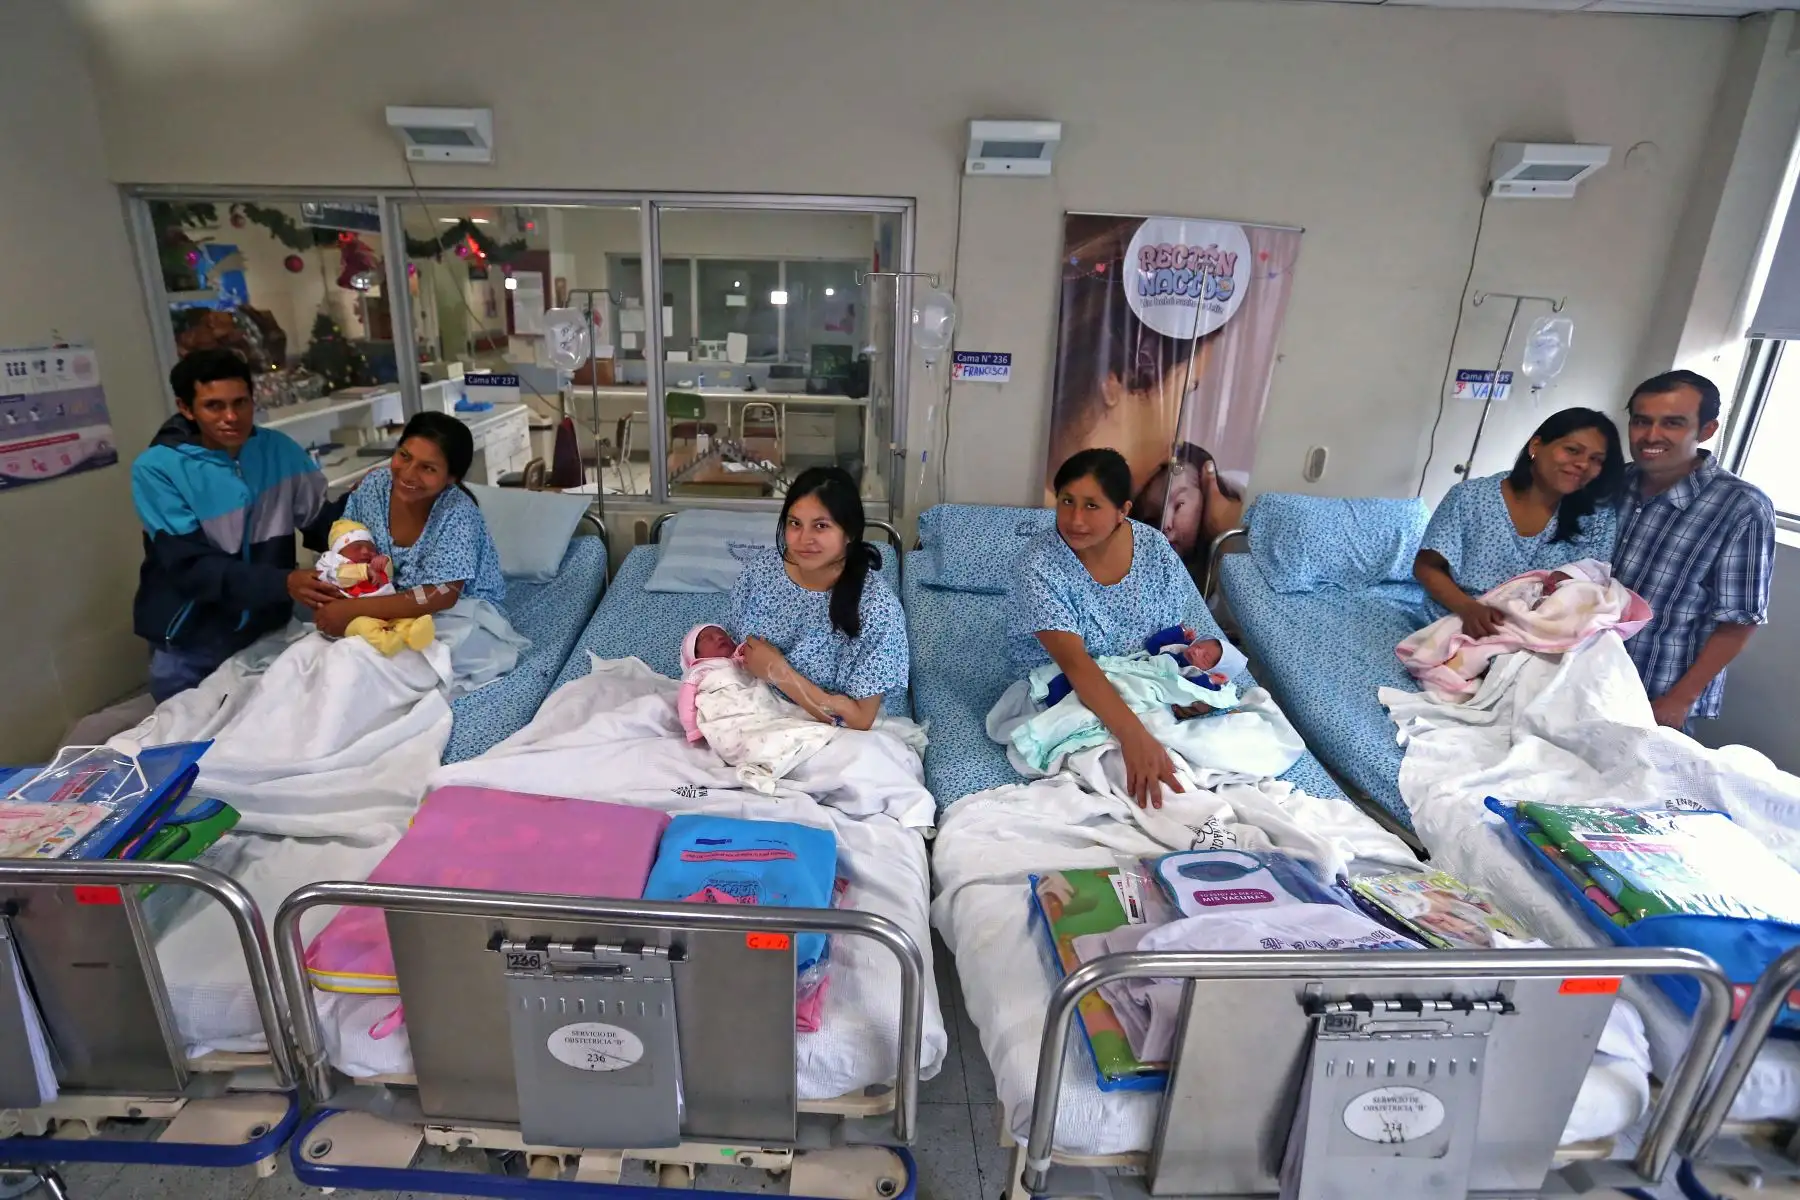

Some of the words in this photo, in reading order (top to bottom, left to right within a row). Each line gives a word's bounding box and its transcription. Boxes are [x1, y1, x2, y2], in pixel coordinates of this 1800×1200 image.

[957, 354, 980, 363] Cama
[992, 355, 1008, 364] 236
[963, 365, 1008, 377] FRANCISCA
[468, 375, 489, 384] Cama
[502, 377, 516, 385] 237
[1460, 372, 1482, 381] Cama
[511, 954, 538, 967] 236
[564, 1037, 612, 1045] OBSTETRICIA
[587, 1053, 606, 1063] 236
[1373, 1095, 1408, 1103] SERVICIO
[1363, 1104, 1413, 1112] OBSTETRICIA
